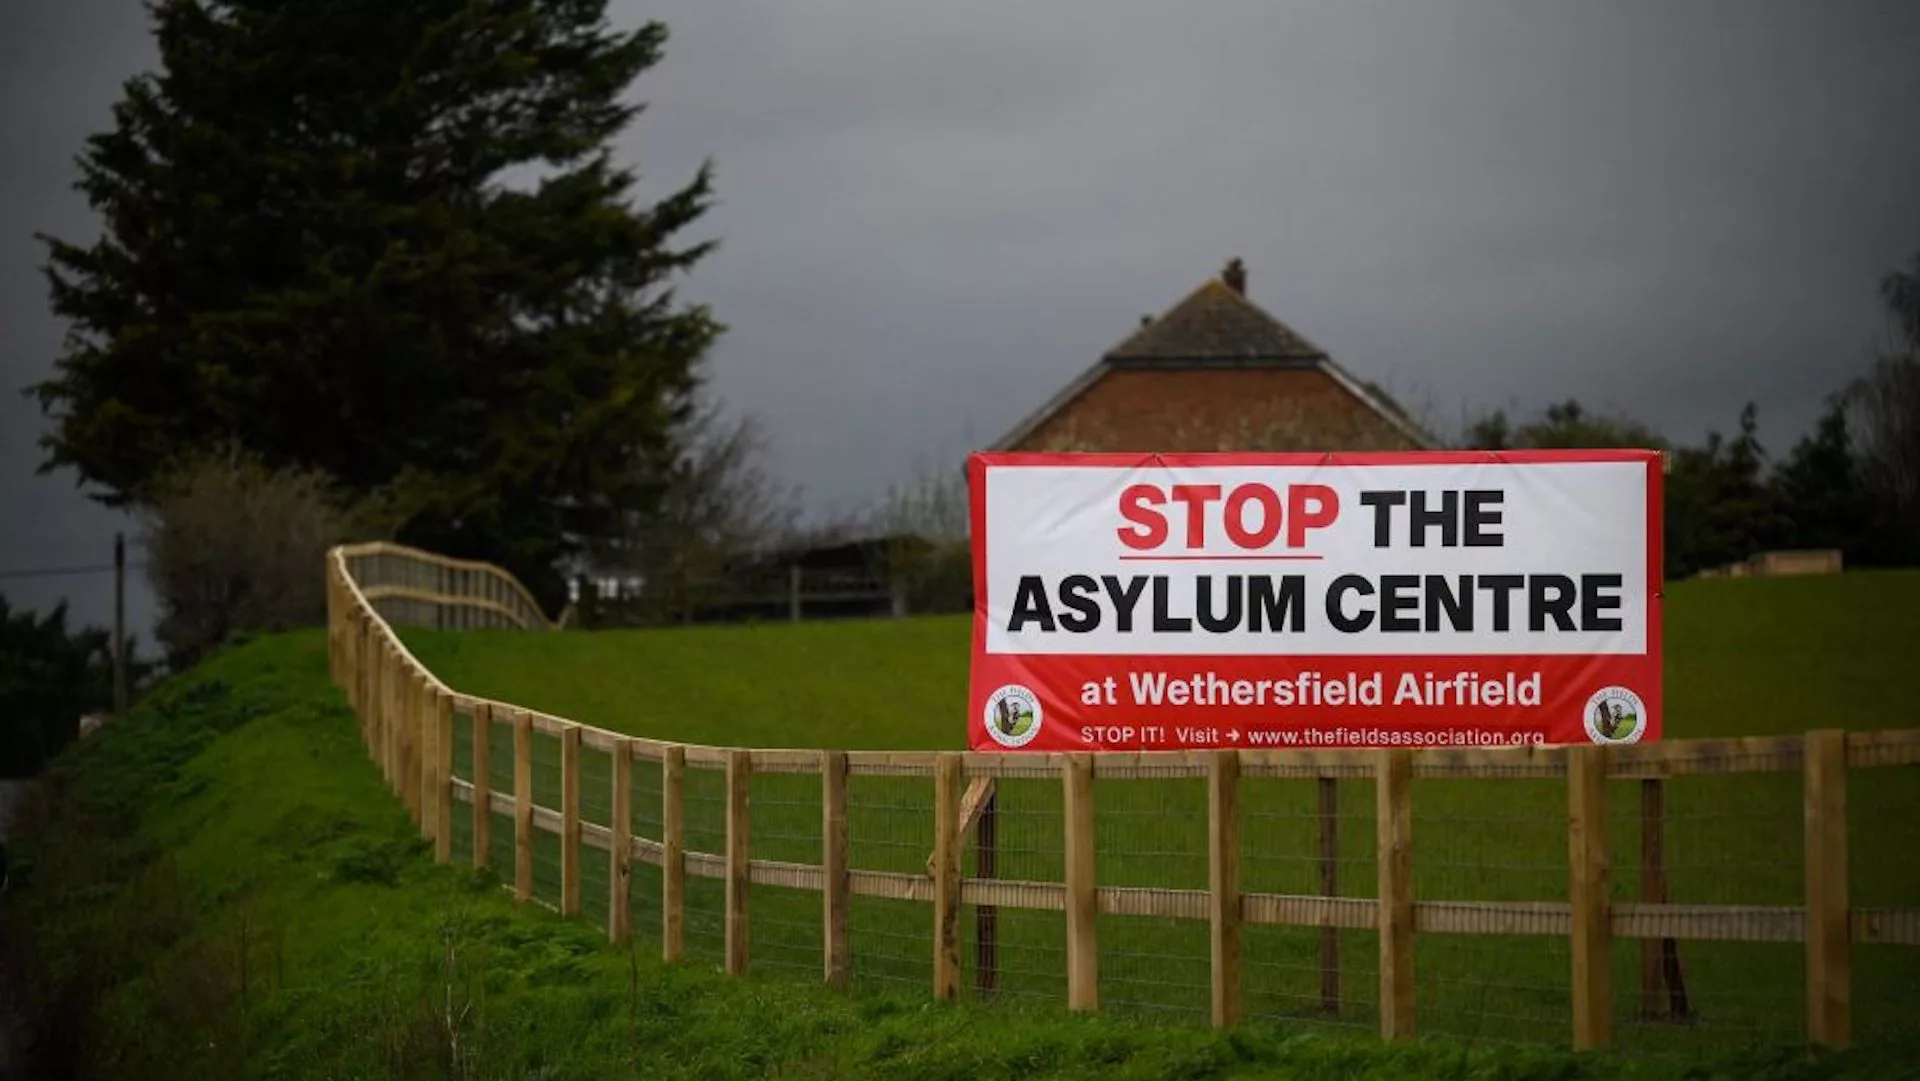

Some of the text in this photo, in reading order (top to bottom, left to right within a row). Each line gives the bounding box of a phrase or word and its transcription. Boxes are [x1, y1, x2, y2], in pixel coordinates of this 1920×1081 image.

[1117, 482, 1505, 550] STOP THE
[1007, 573, 1623, 634] ASYLUM CENTRE
[1081, 671, 1541, 706] at Wethersfield Airfield
[1081, 726, 1545, 745] STOP IT! Visit www.thefieldsassociation.org
